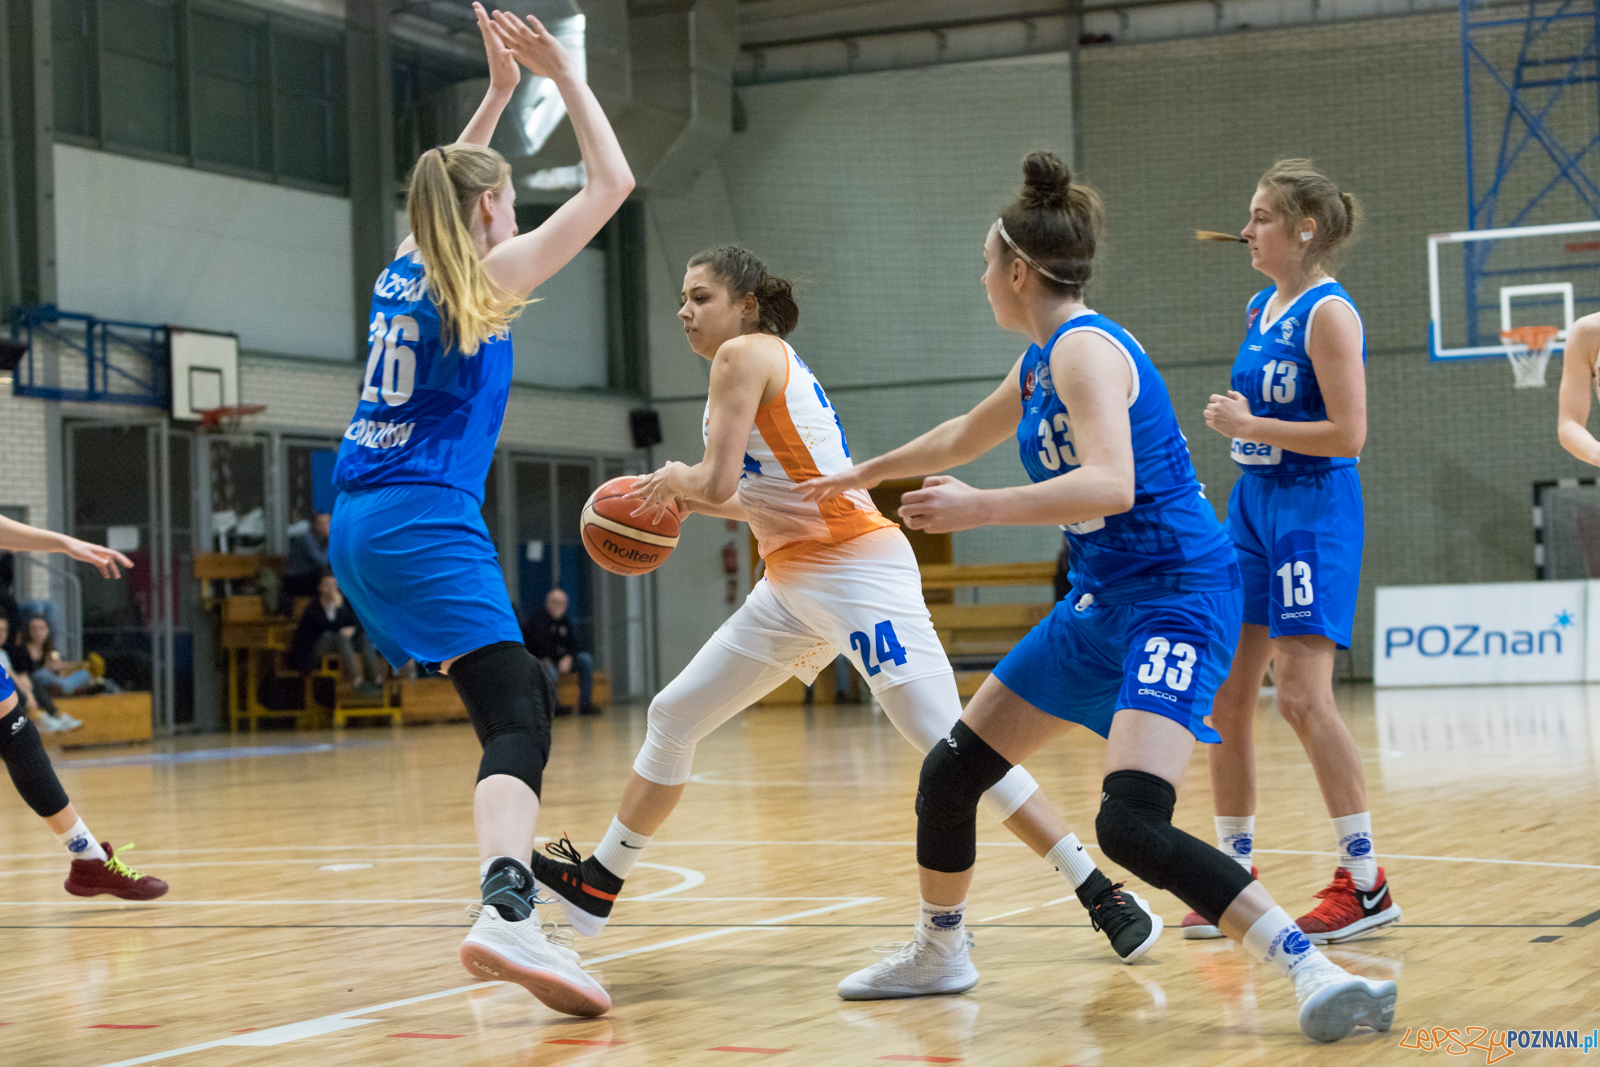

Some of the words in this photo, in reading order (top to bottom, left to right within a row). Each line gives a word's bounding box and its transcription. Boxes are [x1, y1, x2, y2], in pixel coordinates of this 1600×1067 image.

[1262, 359, 1298, 404] 13
[1037, 412, 1081, 471] 33
[1231, 441, 1272, 456] nea
[602, 539, 659, 562] molten
[1276, 560, 1314, 607] 13
[849, 619, 907, 677] 24
[1137, 636, 1197, 691] 33
